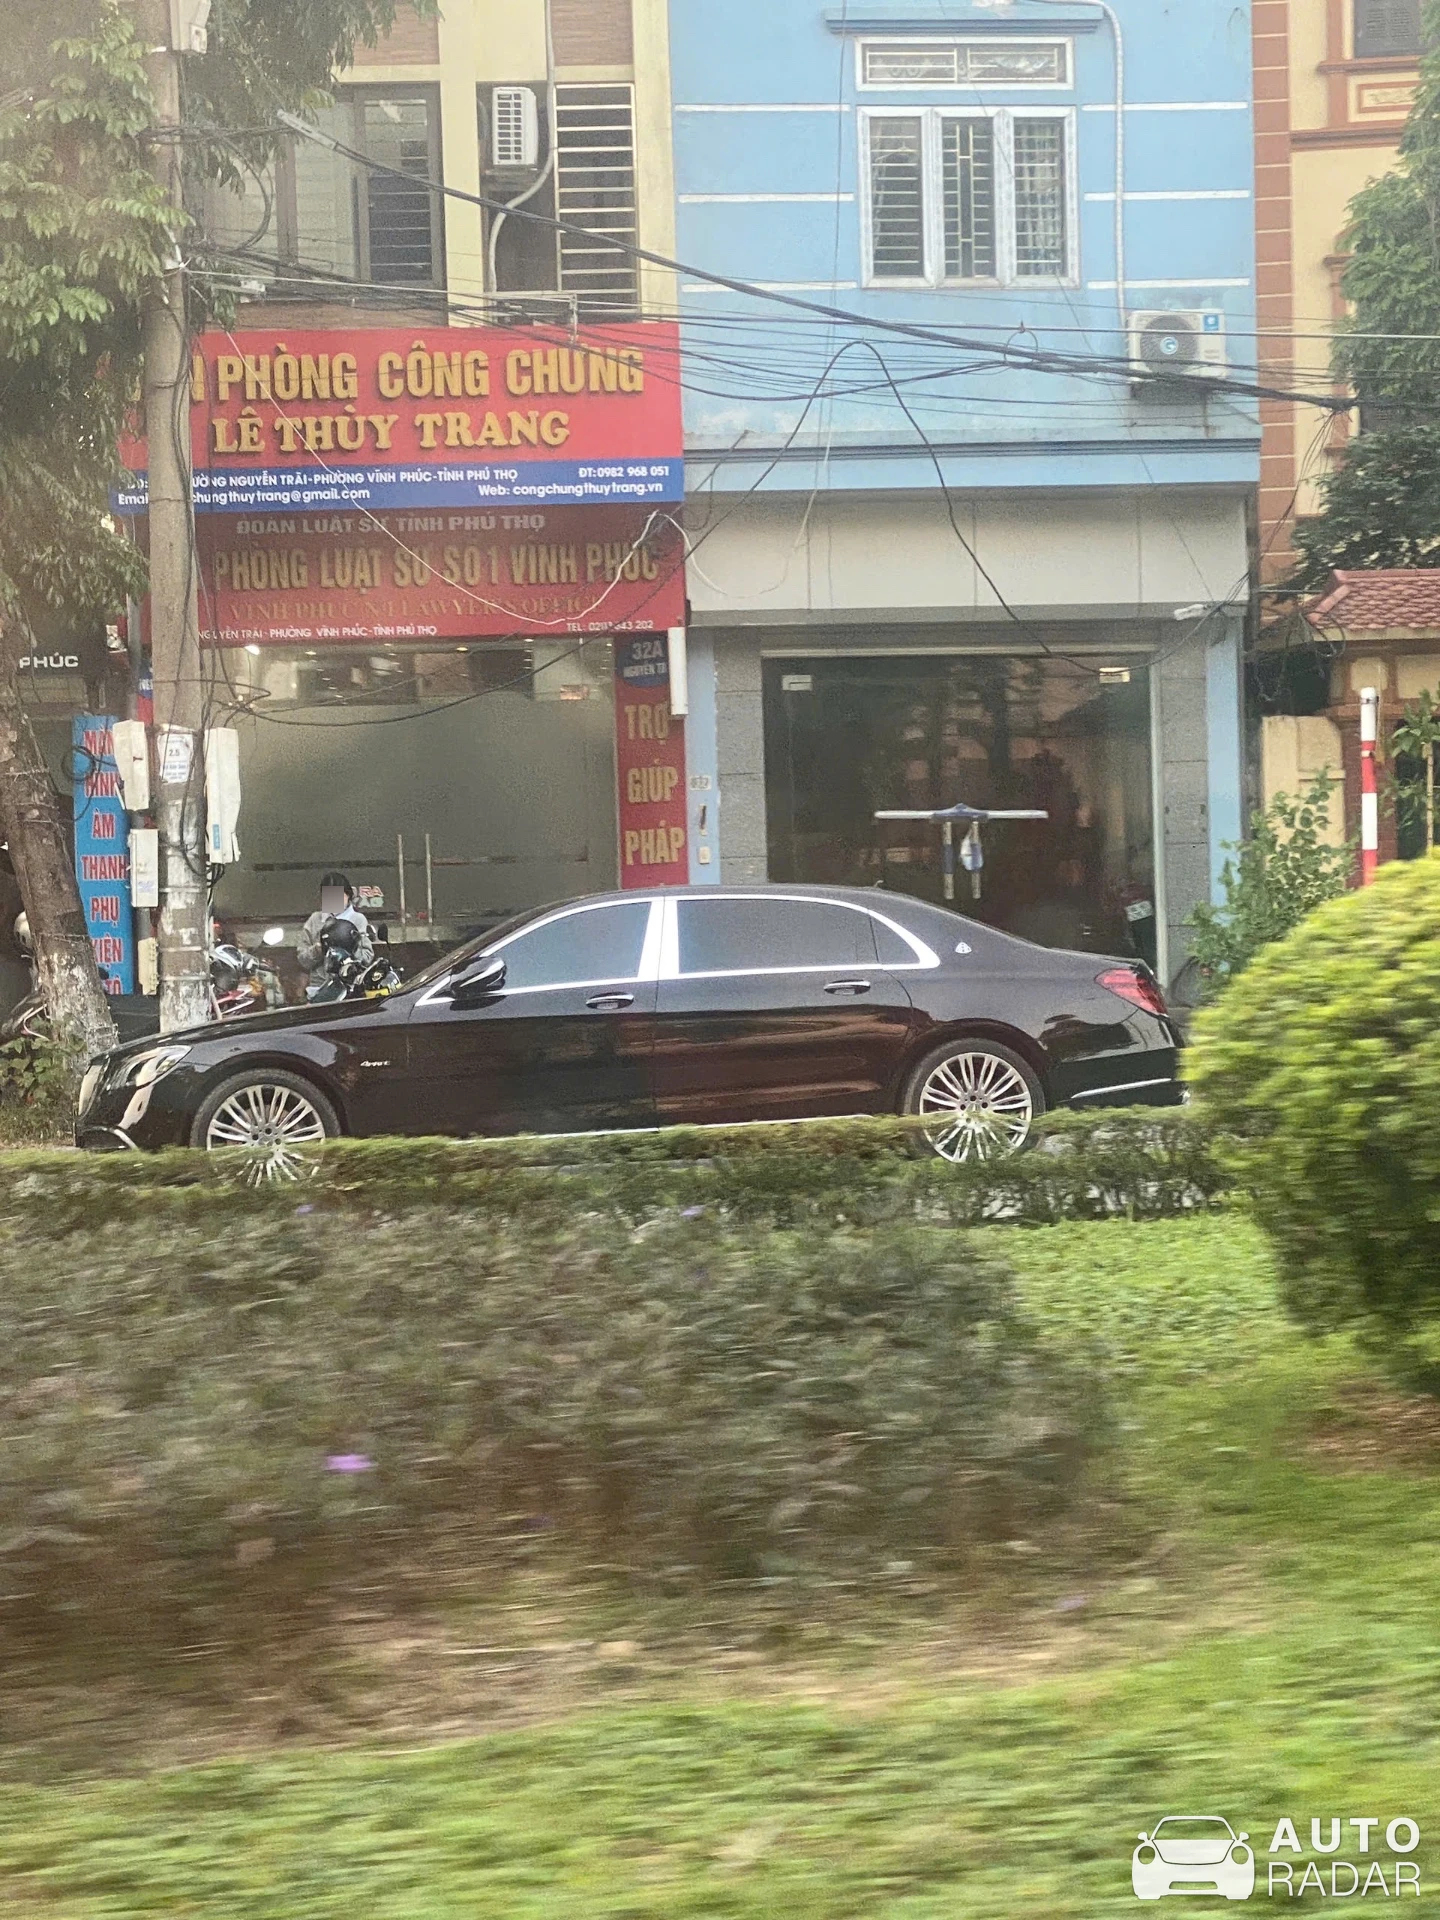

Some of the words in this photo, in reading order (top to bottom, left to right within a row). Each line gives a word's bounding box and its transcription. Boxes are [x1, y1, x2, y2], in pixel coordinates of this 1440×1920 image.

[217, 342, 358, 401] PHÒNG
[378, 340, 490, 398] CÔNG
[212, 405, 265, 453] LÊ
[414, 410, 570, 448] TRANG
[193, 473, 226, 488] ƯỜNG
[229, 470, 277, 487] NGUYỄN
[467, 466, 490, 481] PHÚ
[494, 468, 518, 483] THỌ
[628, 466, 648, 477] 968
[650, 465, 669, 477] 051
[478, 484, 511, 496] Web:
[512, 482, 663, 498] congchungthuytrang.vn
[634, 620, 654, 630] 202
[19, 652, 79, 669] PHÚC
[628, 758, 679, 804] GIÚP
[625, 820, 685, 865] PHÁP
[81, 854, 129, 881] THANH
[90, 896, 120, 927] PHỤ
